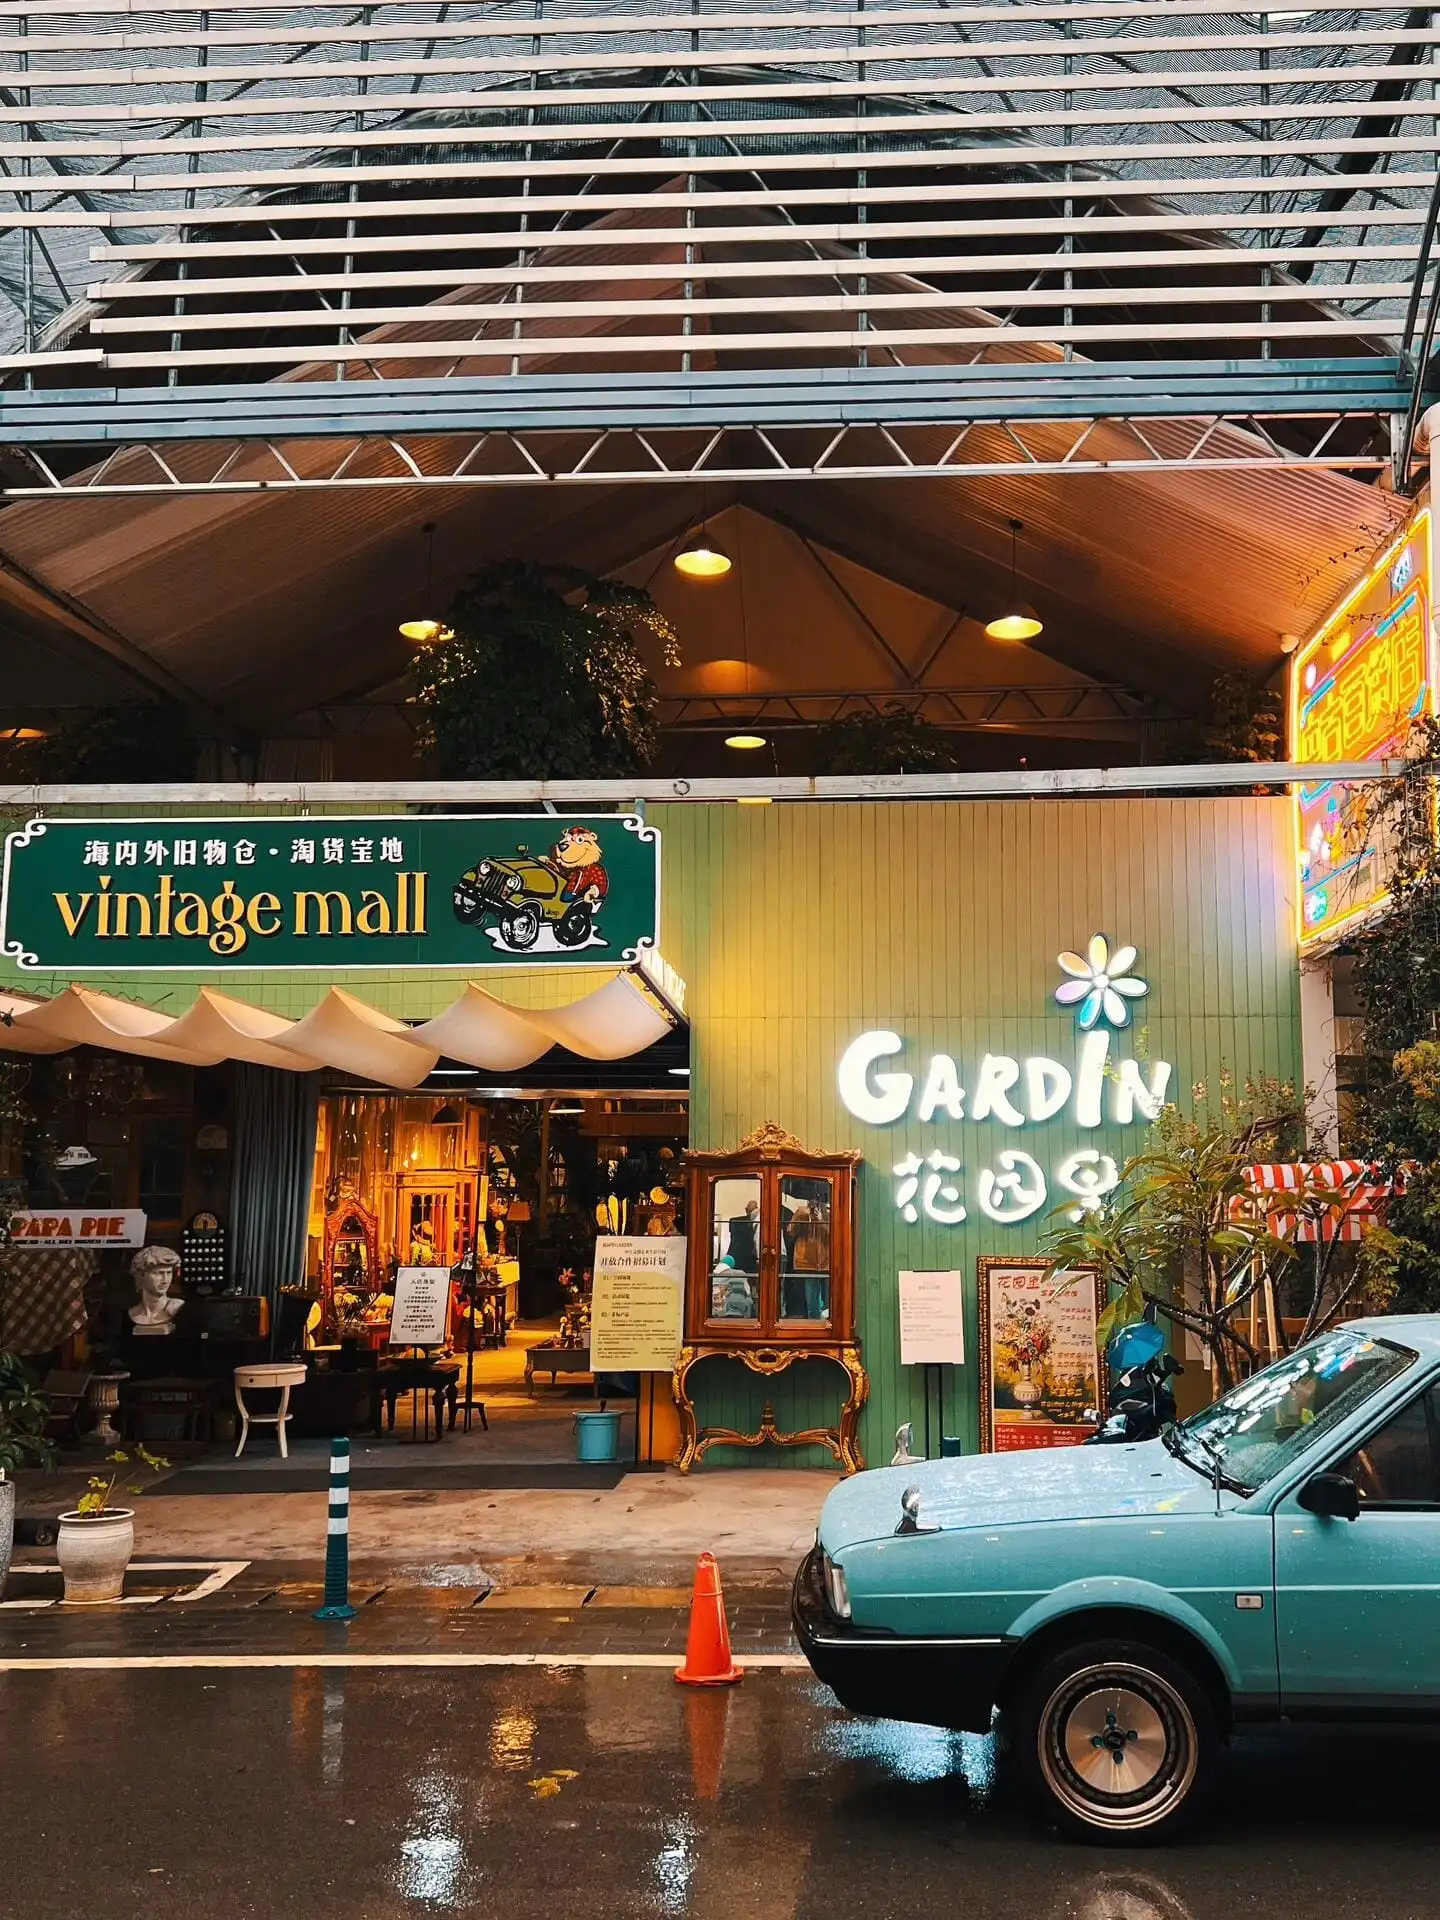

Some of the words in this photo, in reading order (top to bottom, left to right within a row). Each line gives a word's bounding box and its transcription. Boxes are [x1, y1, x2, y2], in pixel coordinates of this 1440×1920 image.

[83, 837, 405, 866] 海内外旧物仓·淘货宝地
[53, 874, 283, 955] vintage
[292, 871, 427, 936] mall
[838, 1030, 1172, 1128] GARDIN
[892, 1148, 1120, 1223] 花园里
[10, 1217, 73, 1237] PAPA
[80, 1216, 125, 1236] PIE
